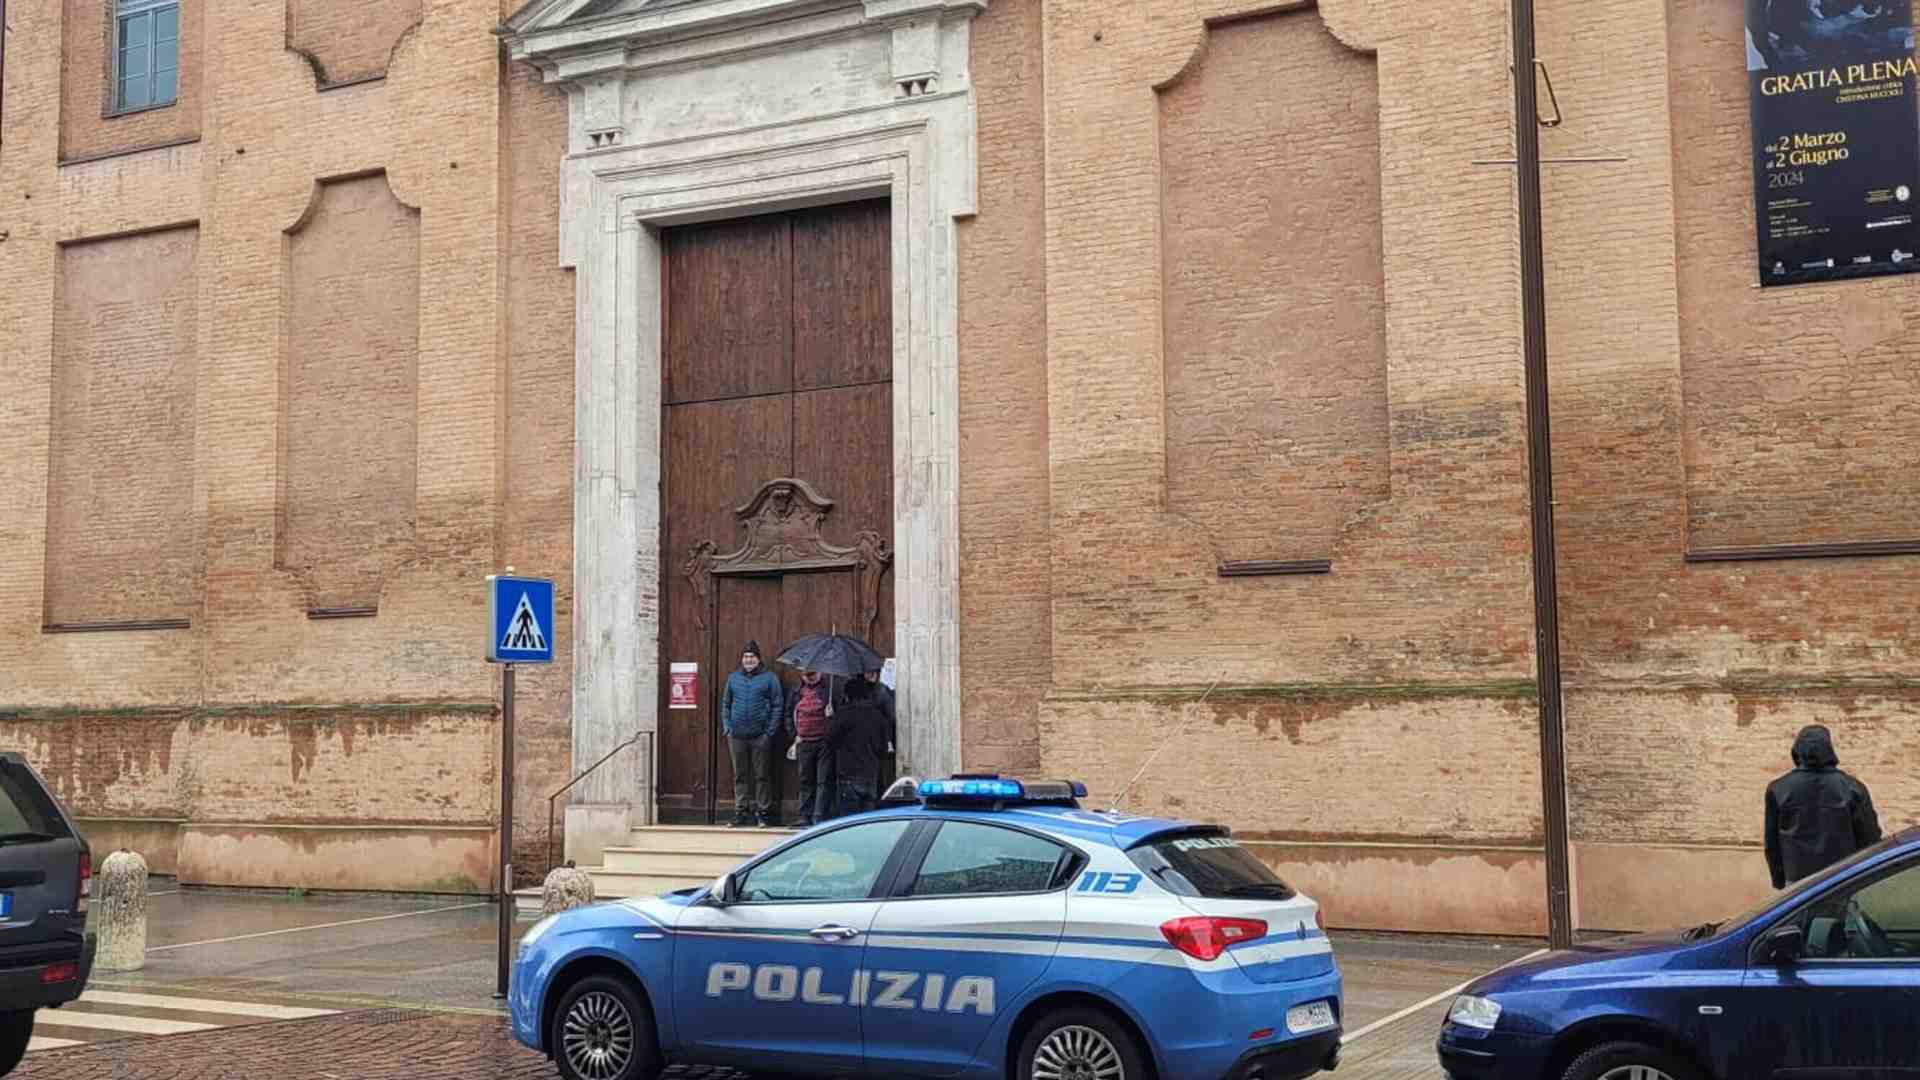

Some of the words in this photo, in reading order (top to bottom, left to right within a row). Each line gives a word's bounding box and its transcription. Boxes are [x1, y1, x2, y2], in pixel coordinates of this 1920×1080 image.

[1760, 67, 1842, 96] GRATIA
[1847, 57, 1918, 84] PLENA
[1779, 136, 1790, 151] 2
[1793, 131, 1846, 149] Marzo
[1776, 153, 1786, 168] 2
[1790, 147, 1849, 166] Giugno
[1768, 170, 1804, 188] 2024
[1076, 871, 1143, 894] 113
[704, 961, 996, 1016] POLIZIA
